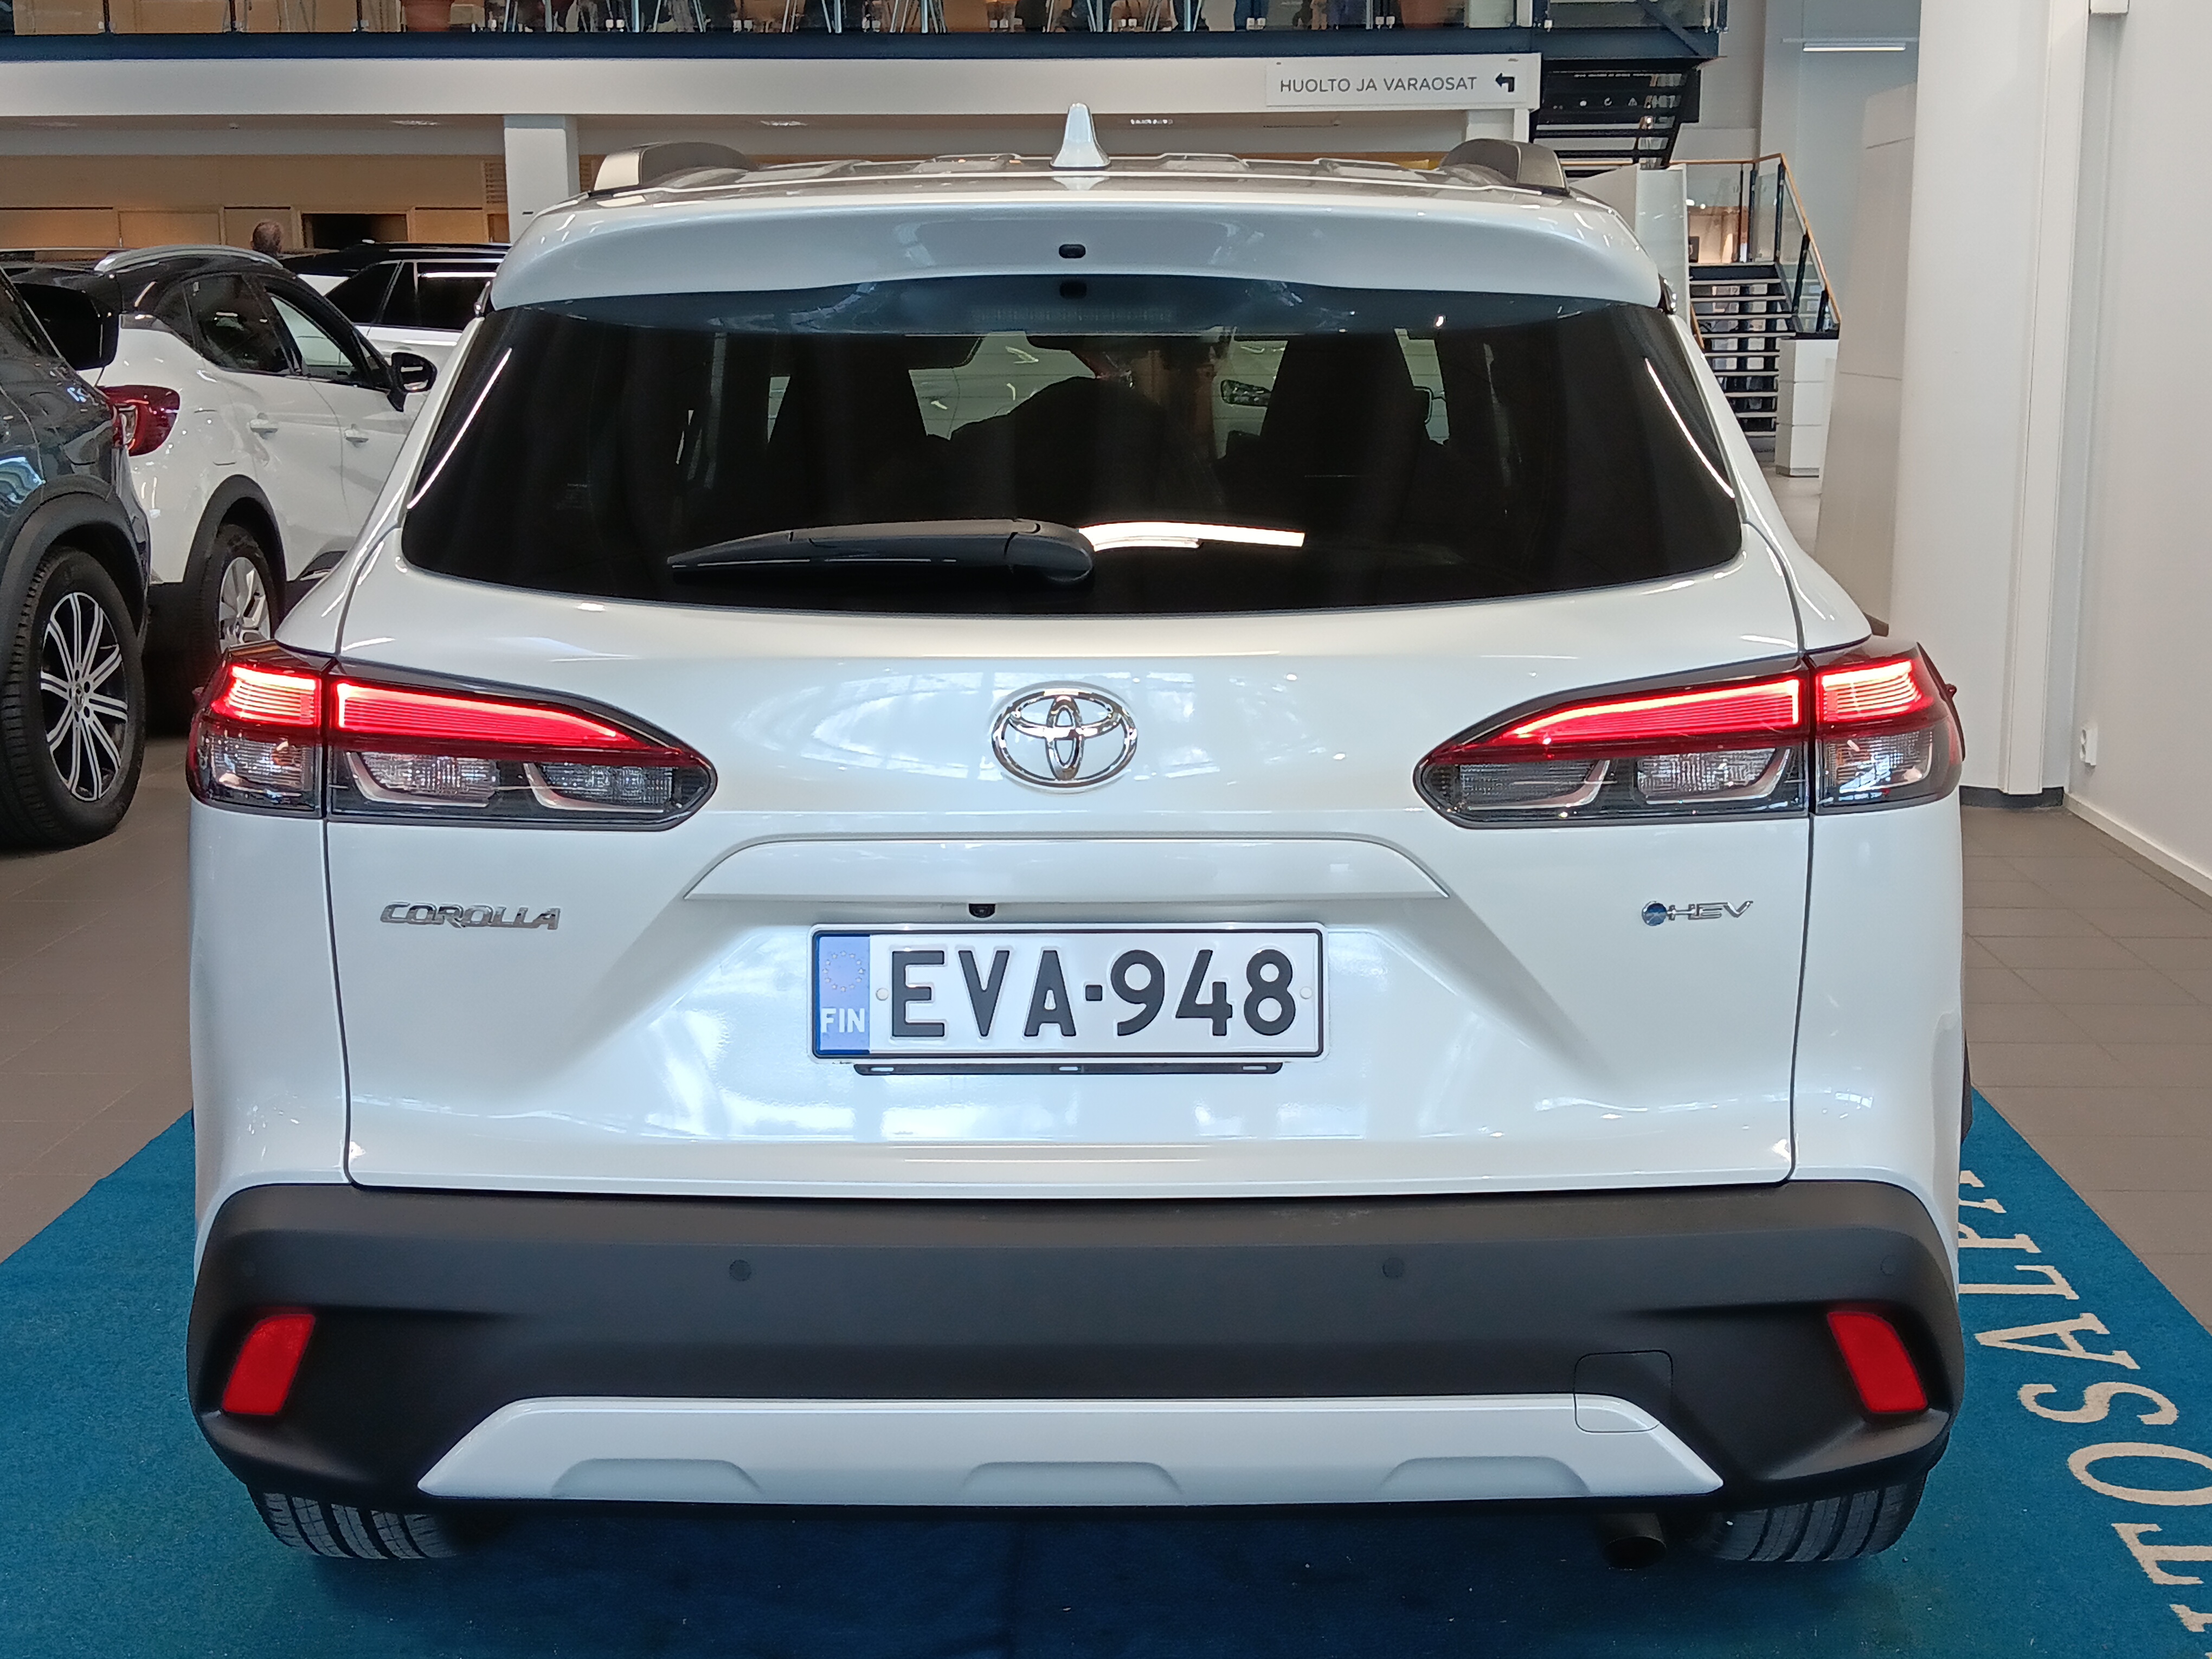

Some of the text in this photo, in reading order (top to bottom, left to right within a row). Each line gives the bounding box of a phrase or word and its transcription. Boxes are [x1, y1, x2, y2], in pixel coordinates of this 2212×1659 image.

[1280, 76, 1477, 93] HUOLTO JA VARAOSAT
[380, 902, 561, 930] COROLLA
[1667, 901, 1754, 921] HEV
[891, 949, 1296, 1038] EVA-948
[820, 1008, 865, 1033] FIN
